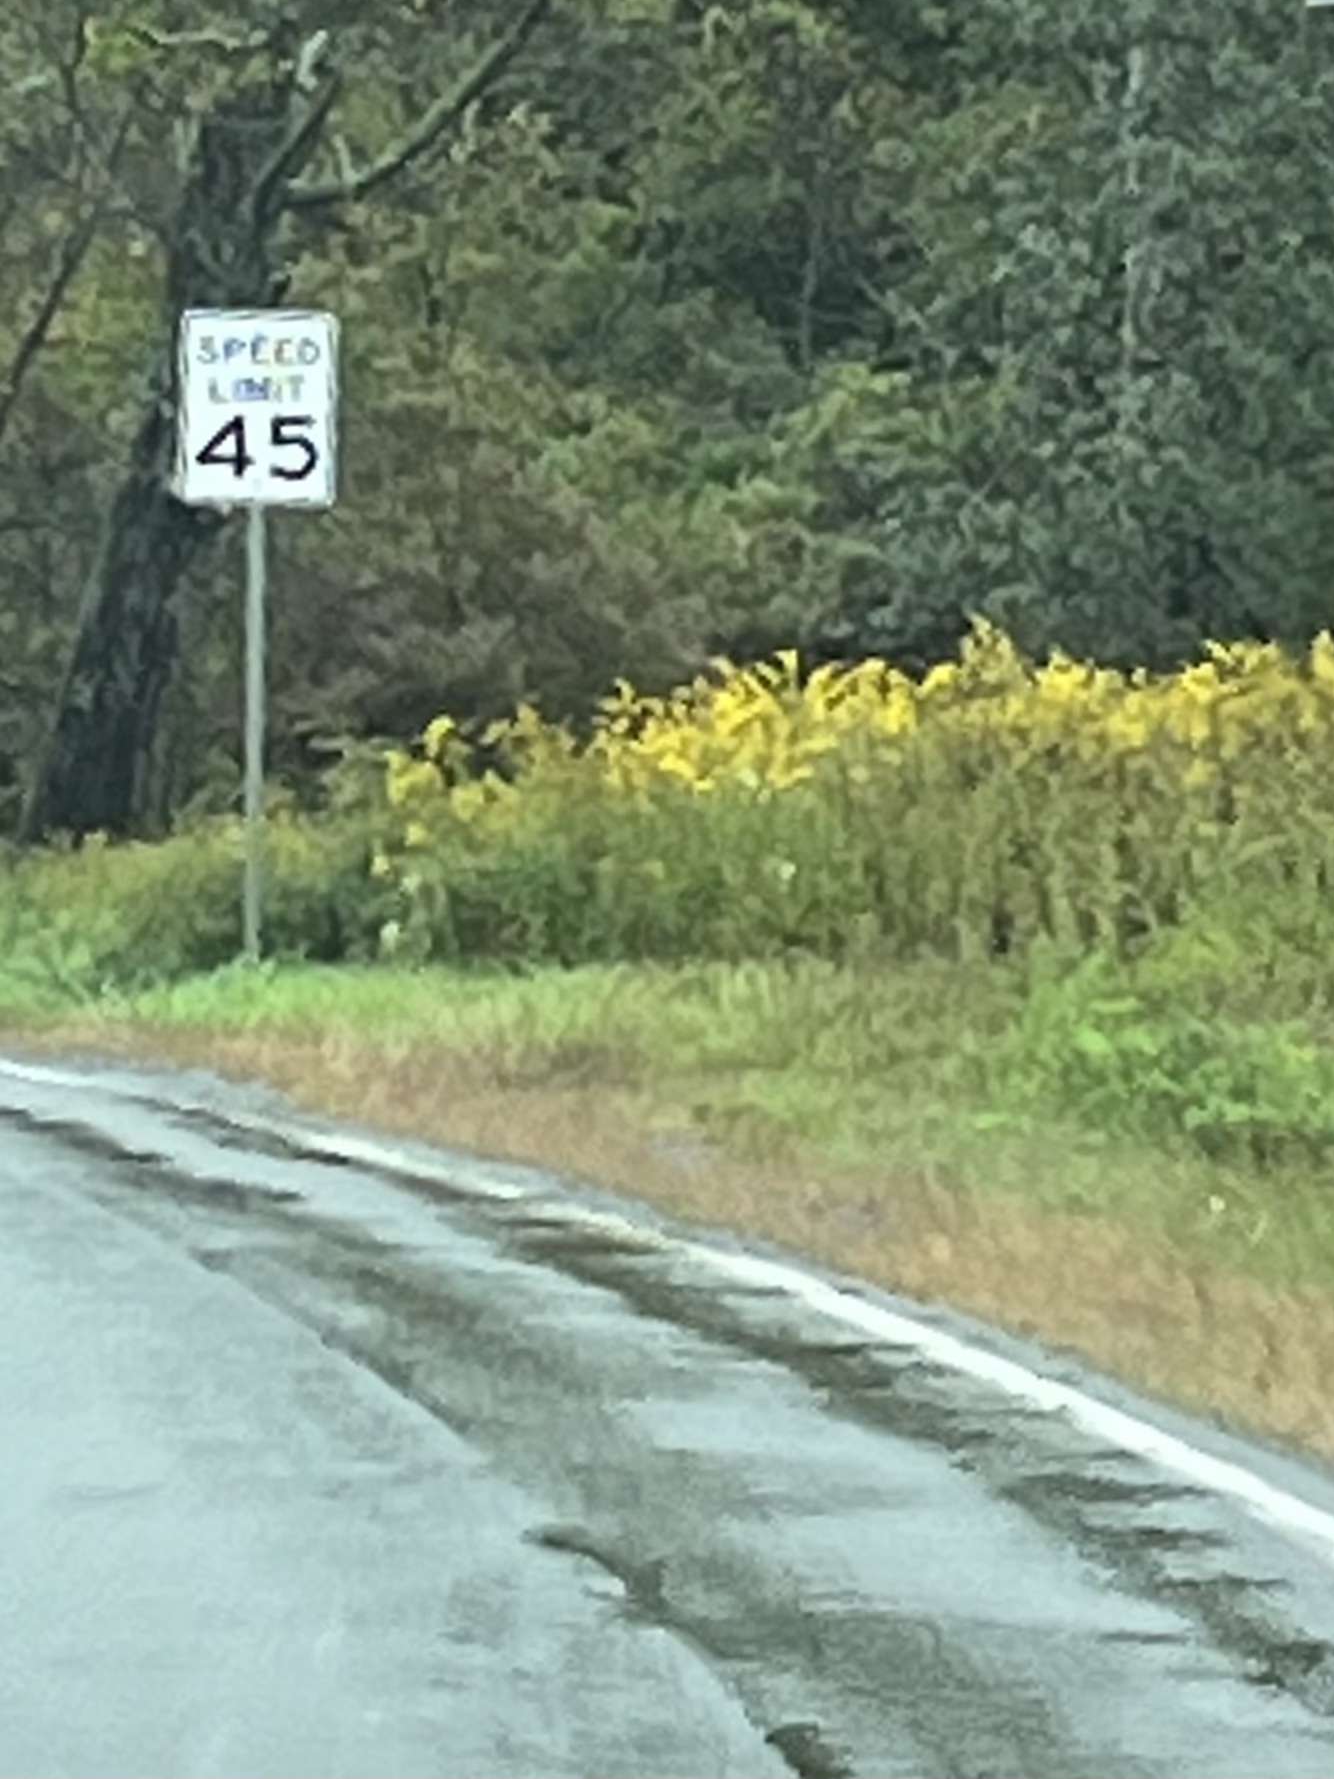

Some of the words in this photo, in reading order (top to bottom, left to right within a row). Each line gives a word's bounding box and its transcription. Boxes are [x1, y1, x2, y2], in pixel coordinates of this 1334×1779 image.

[197, 333, 321, 366] SPEED
[208, 374, 304, 404] LIMIT
[195, 414, 319, 481] 45
